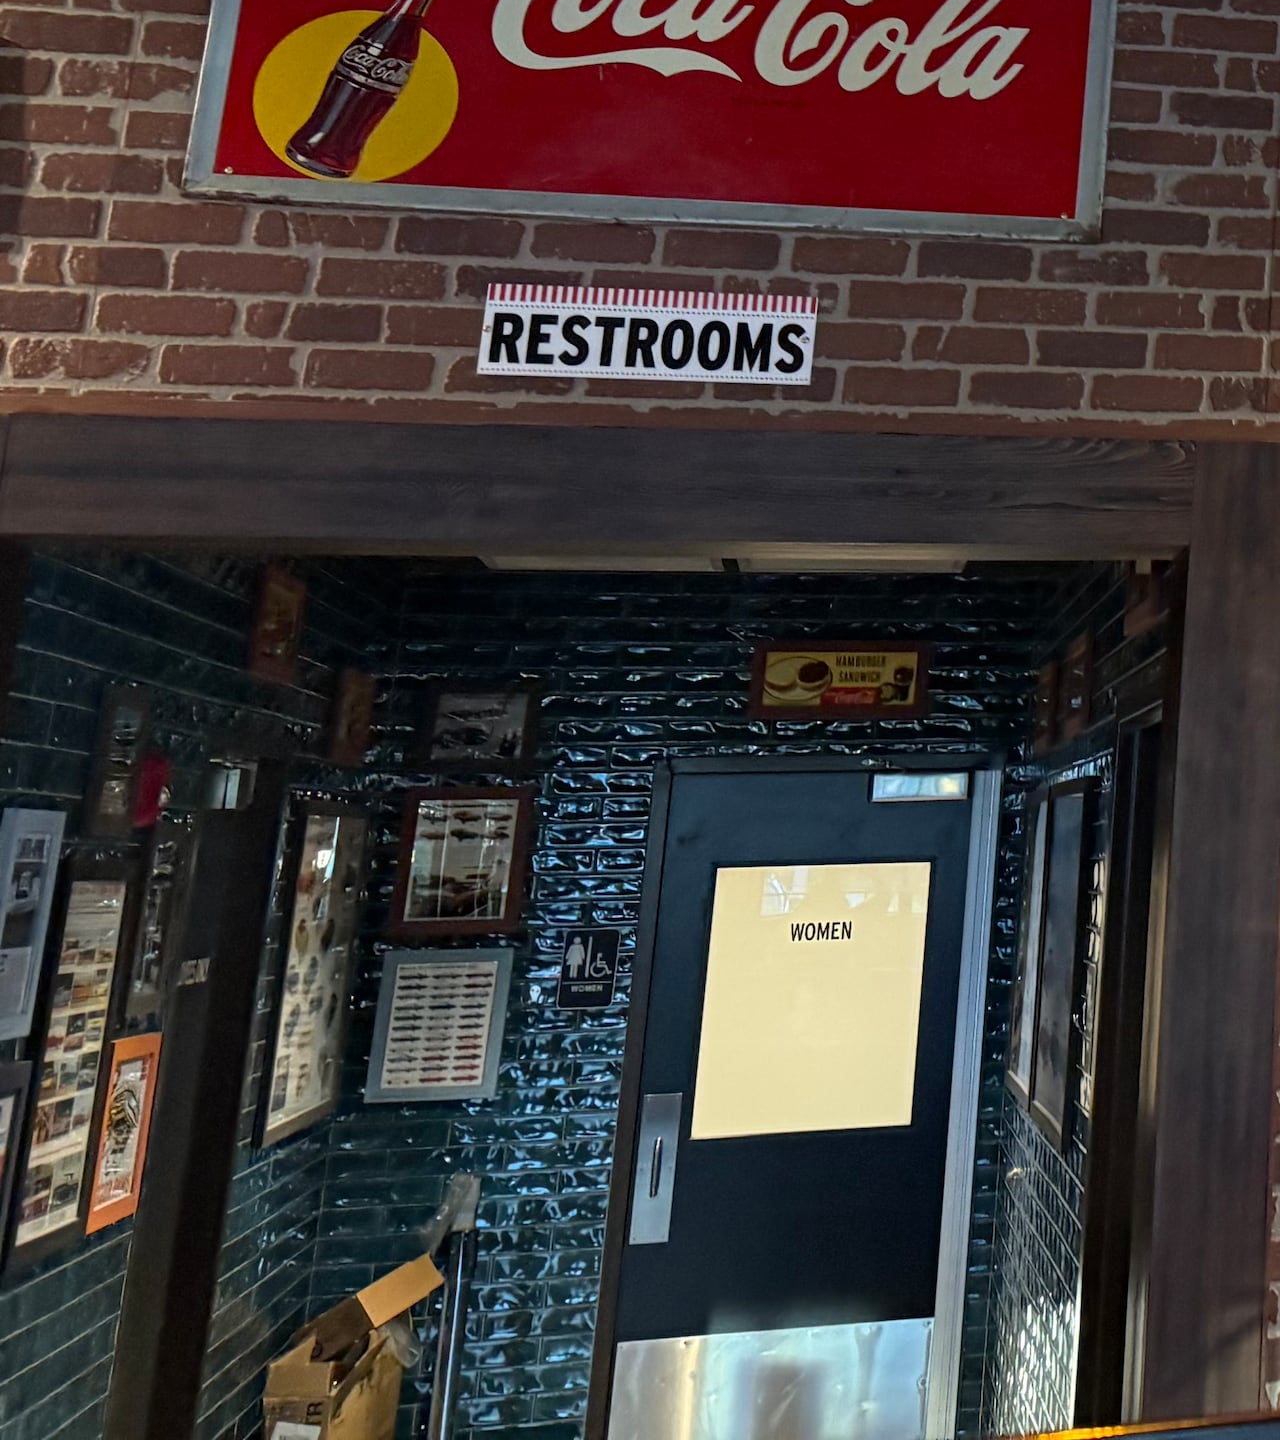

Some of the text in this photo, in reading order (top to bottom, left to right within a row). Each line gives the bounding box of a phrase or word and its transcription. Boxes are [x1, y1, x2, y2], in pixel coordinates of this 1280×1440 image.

[487, 312, 807, 374] RESTROOMS
[791, 921, 852, 942] WOMEN
[570, 983, 603, 993] WOMEN
